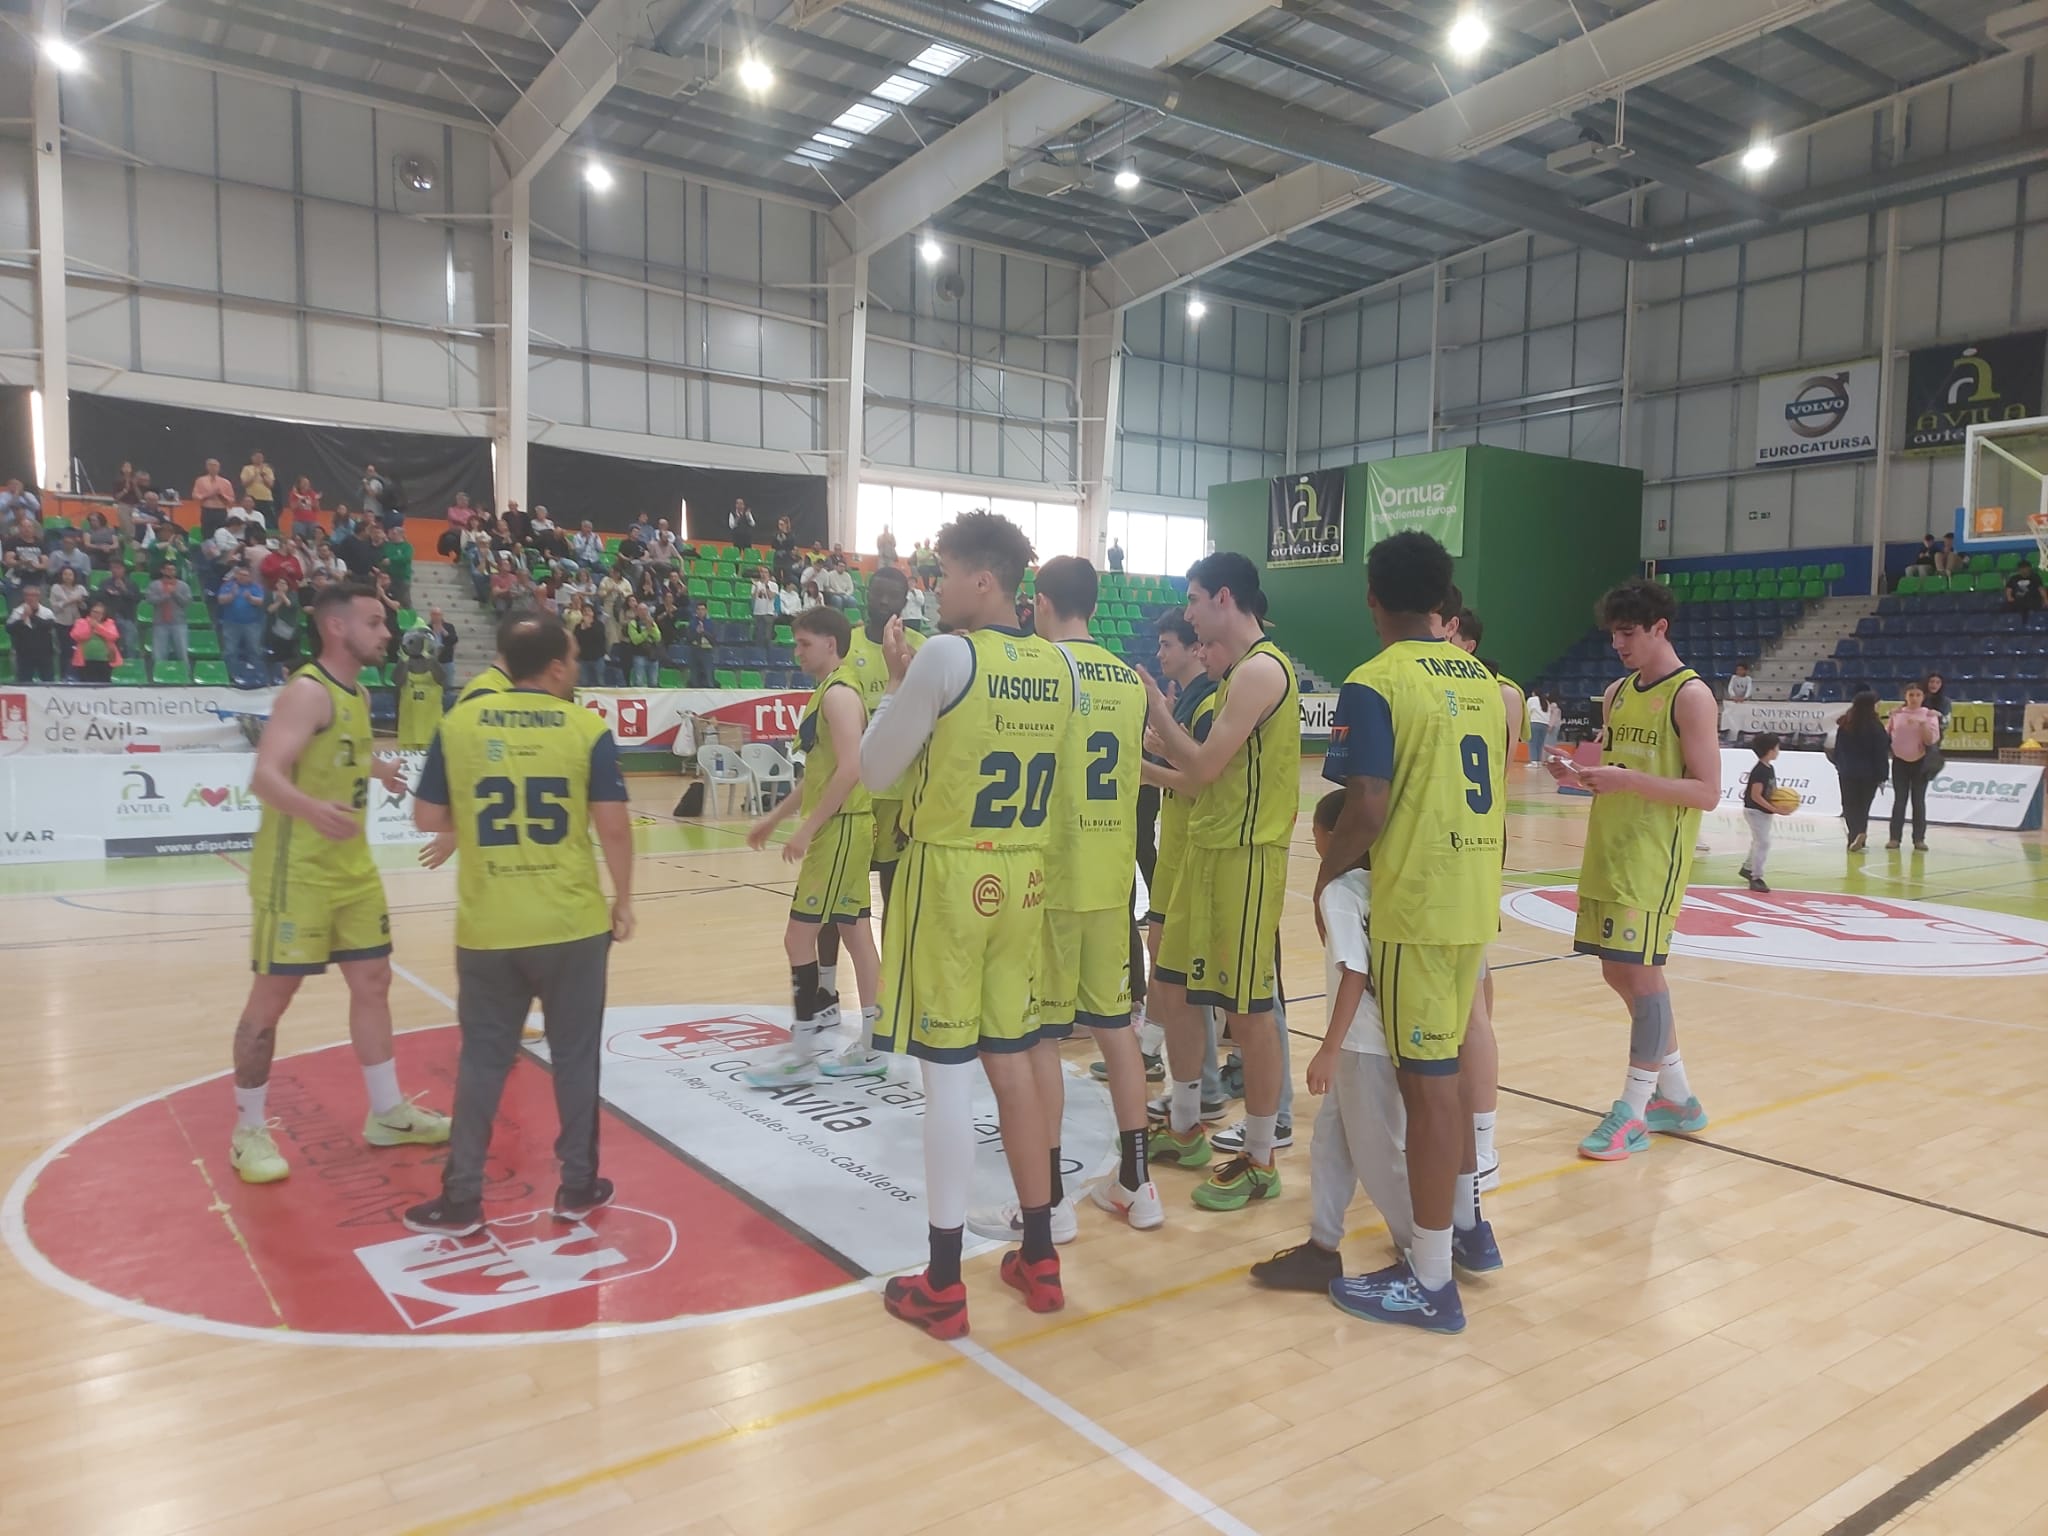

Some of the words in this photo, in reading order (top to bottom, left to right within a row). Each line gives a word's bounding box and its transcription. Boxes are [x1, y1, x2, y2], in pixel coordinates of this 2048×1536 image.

[1789, 399, 1845, 415] VOLVO
[1759, 435, 1872, 459] EUROCATURSA
[1381, 482, 1445, 508] Ornua
[1272, 525, 1339, 545] ÁVILA
[1271, 542, 1339, 557] auténtica
[1416, 658, 1488, 681] TAVERAS
[987, 673, 1059, 703] VASQUEZ
[44, 695, 219, 719] Ayuntamiento
[478, 708, 566, 729] ANTONIO
[1751, 708, 1825, 721] UNIVERSIDAD
[44, 720, 77, 742] de
[84, 717, 149, 741] Ávila
[1751, 717, 1825, 733] CATÓLICA
[1086, 730, 1120, 801] 2
[1459, 733, 1493, 815] 9
[970, 750, 1057, 829] 20
[1932, 775, 2028, 797] Center
[474, 775, 571, 847] 25
[1602, 917, 1614, 939] 9
[1191, 958, 1206, 982] 3
[750, 1081, 872, 1133] Ávila
[740, 1108, 790, 1133] Leales
[829, 1155, 919, 1203] Caballeros
